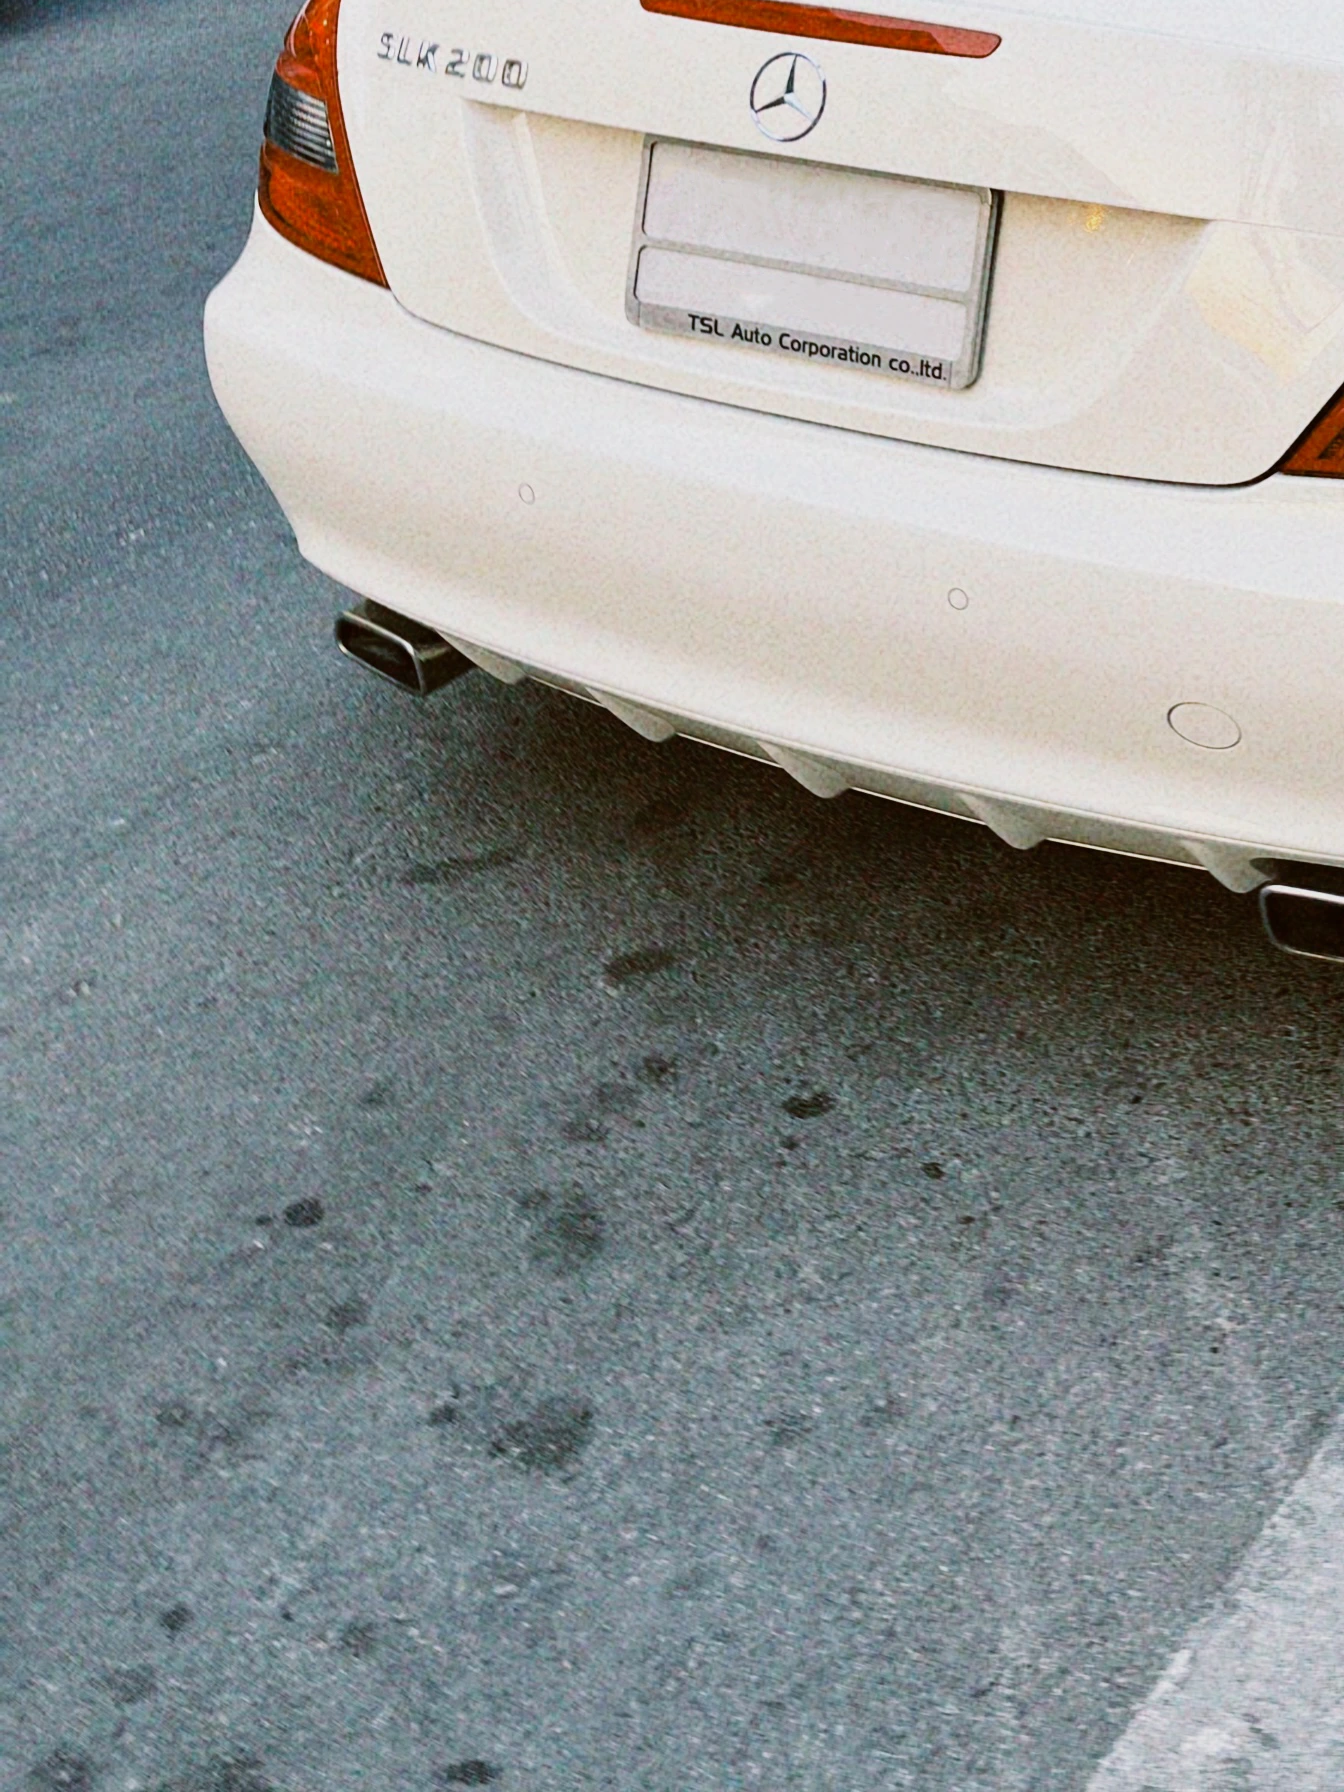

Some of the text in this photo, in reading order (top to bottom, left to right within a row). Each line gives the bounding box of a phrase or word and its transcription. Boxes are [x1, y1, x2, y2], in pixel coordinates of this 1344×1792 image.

[687, 313, 725, 337] TSL
[730, 323, 772, 347] Auto
[778, 332, 882, 369] Corporation
